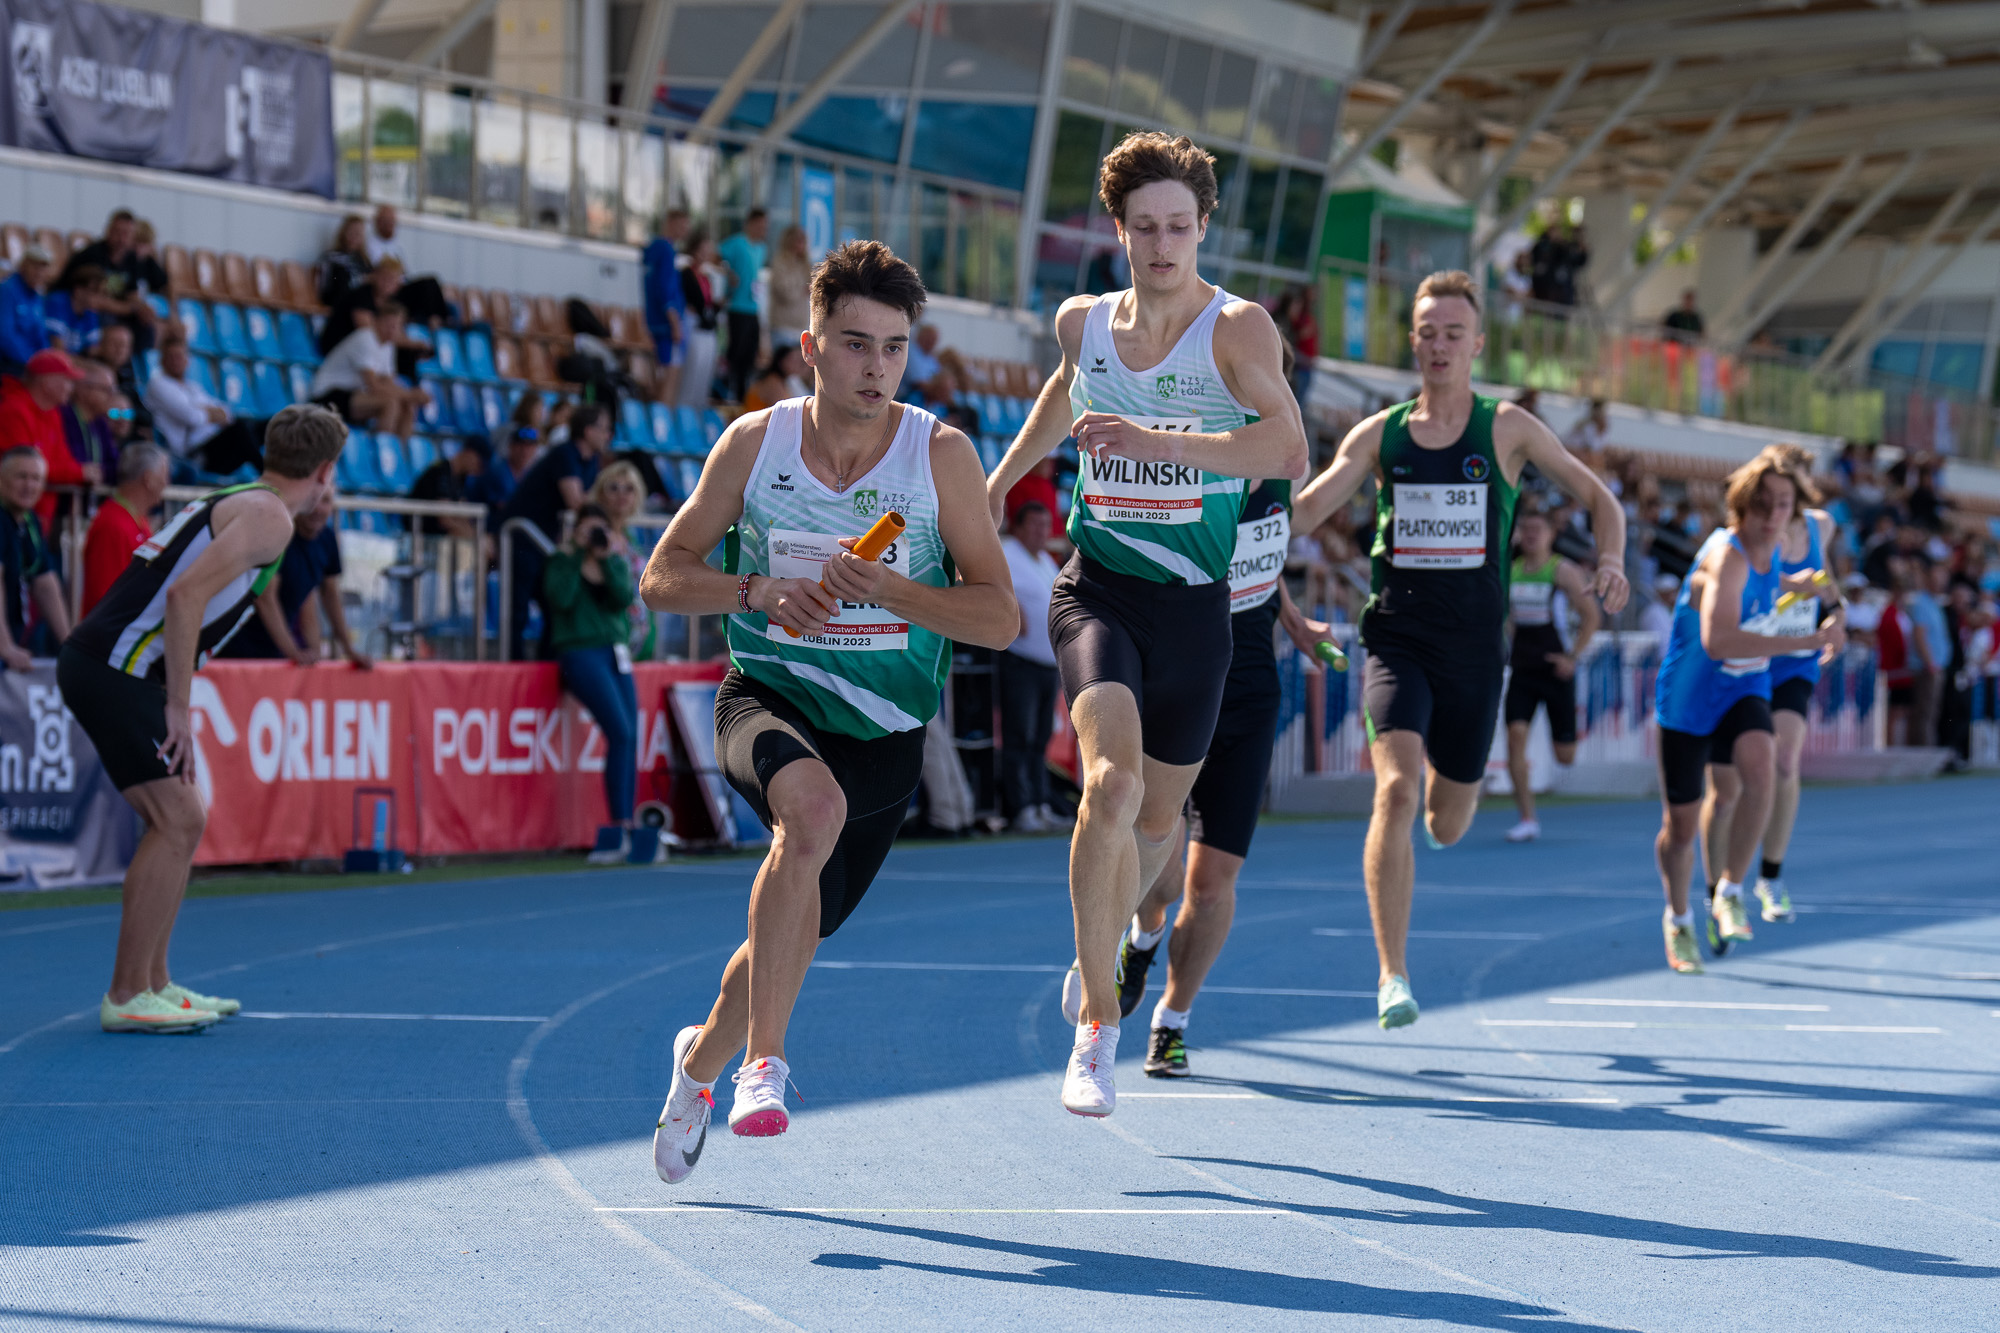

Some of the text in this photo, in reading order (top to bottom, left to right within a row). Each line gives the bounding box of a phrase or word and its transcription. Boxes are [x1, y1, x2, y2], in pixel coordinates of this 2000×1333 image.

[1181, 376, 1200, 386] AZS
[771, 482, 795, 492] erima
[882, 493, 906, 503] AZS
[1098, 497, 1114, 505] PZLA
[1115, 499, 1157, 508] Mistrzostwa
[1158, 501, 1180, 509] Polski
[1181, 500, 1195, 508] U20
[1445, 490, 1477, 506] 381
[1108, 509, 1171, 520] LUBLIN 2023
[1253, 520, 1283, 542] 372
[1397, 518, 1482, 537] PŁATKOWSKI
[790, 542, 822, 552] Ministerstwo
[858, 625, 882, 634] Polski
[883, 624, 899, 633] U20
[802, 634, 871, 646] LUBLIN 2023
[247, 696, 391, 784] ORLEN
[432, 708, 571, 776] POLSKI
